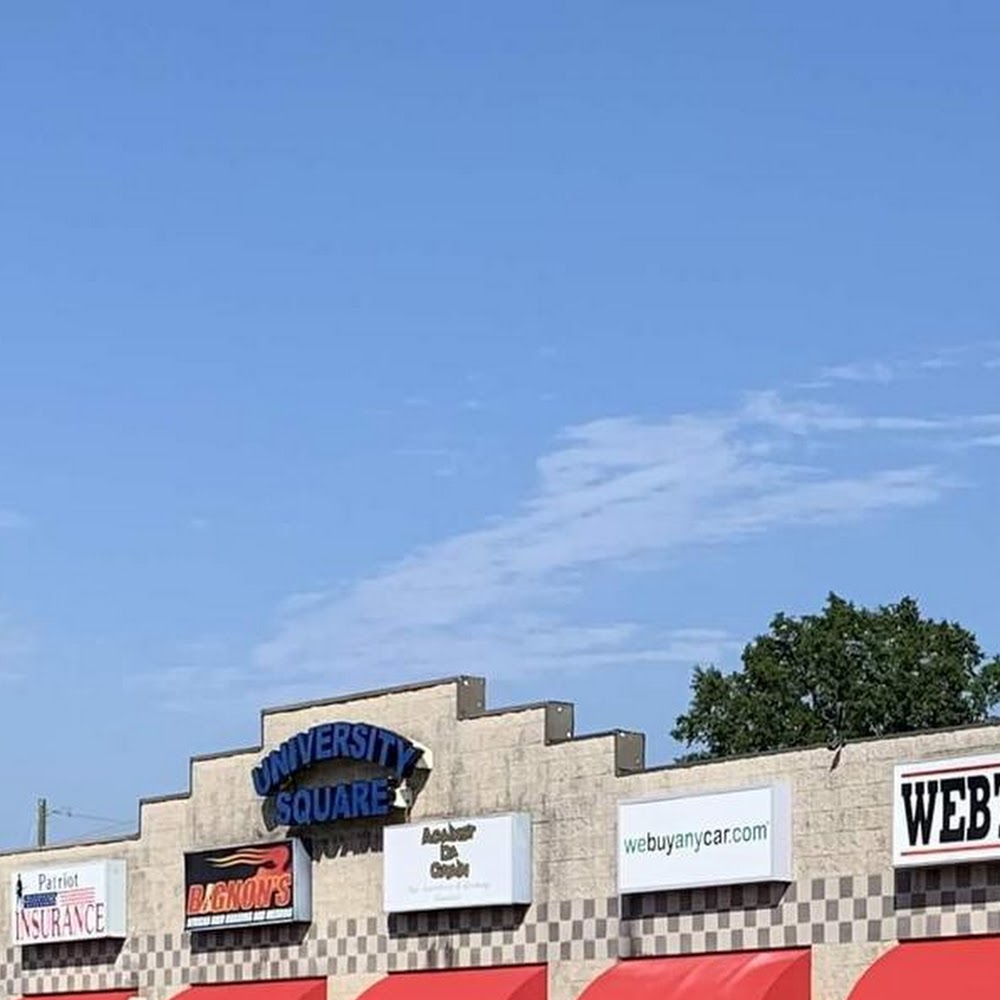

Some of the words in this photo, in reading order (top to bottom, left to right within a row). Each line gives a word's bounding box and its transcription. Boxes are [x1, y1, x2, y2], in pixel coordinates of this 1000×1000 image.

[252, 722, 422, 796] UNIVERSITY
[275, 778, 390, 826] SQUARE
[623, 823, 768, 856] webuyanycar.com
[38, 873, 78, 891] Patriot
[15, 903, 105, 940] INSURANCE
